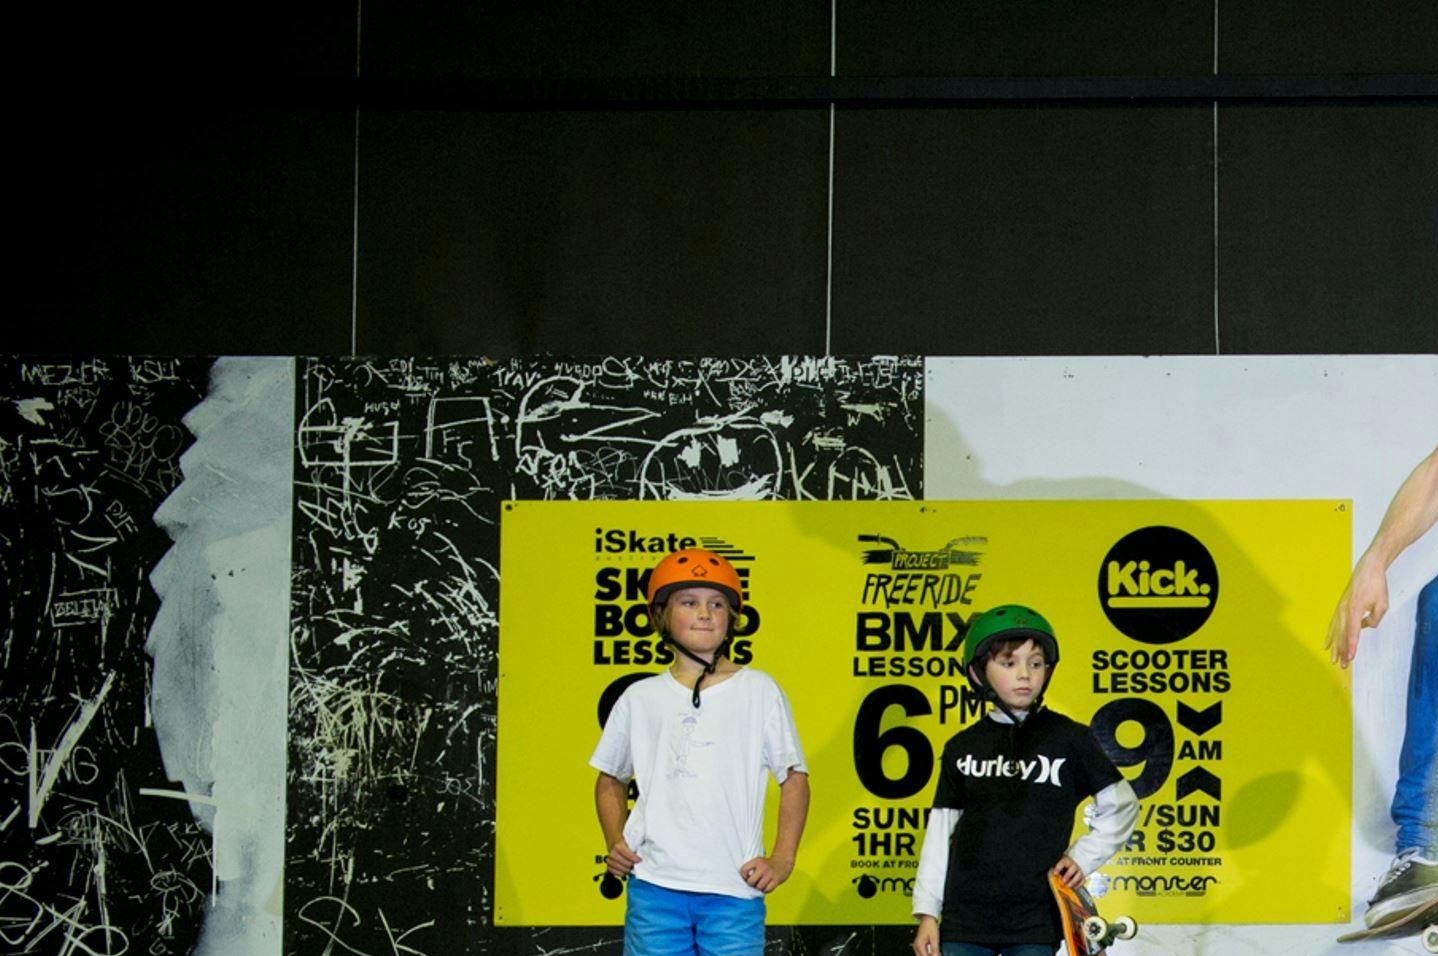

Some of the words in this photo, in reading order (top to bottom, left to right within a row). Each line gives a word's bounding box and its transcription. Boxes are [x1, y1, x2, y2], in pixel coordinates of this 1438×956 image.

[594, 527, 698, 553] iSkate
[894, 552, 949, 568] PROJECT
[594, 567, 750, 601] SKE
[862, 573, 983, 609] FREERIDE
[1107, 560, 1211, 596] Kick.
[594, 604, 761, 637] BOD
[856, 611, 981, 652] BMX
[593, 640, 753, 665] LESSS
[1092, 649, 1228, 671] SCOOTER
[853, 656, 966, 677] LESSON
[1092, 672, 1231, 694] LESSONS
[853, 684, 934, 800] 6
[1090, 697, 1175, 800] 9
[1178, 740, 1222, 760] AM
[852, 832, 916, 856] 1HR
[1157, 827, 1216, 855] $30
[850, 859, 881, 869] BOOK
[883, 859, 896, 869] AT
[1131, 857, 1167, 867] FRONT
[1169, 857, 1222, 867] COUNTER
